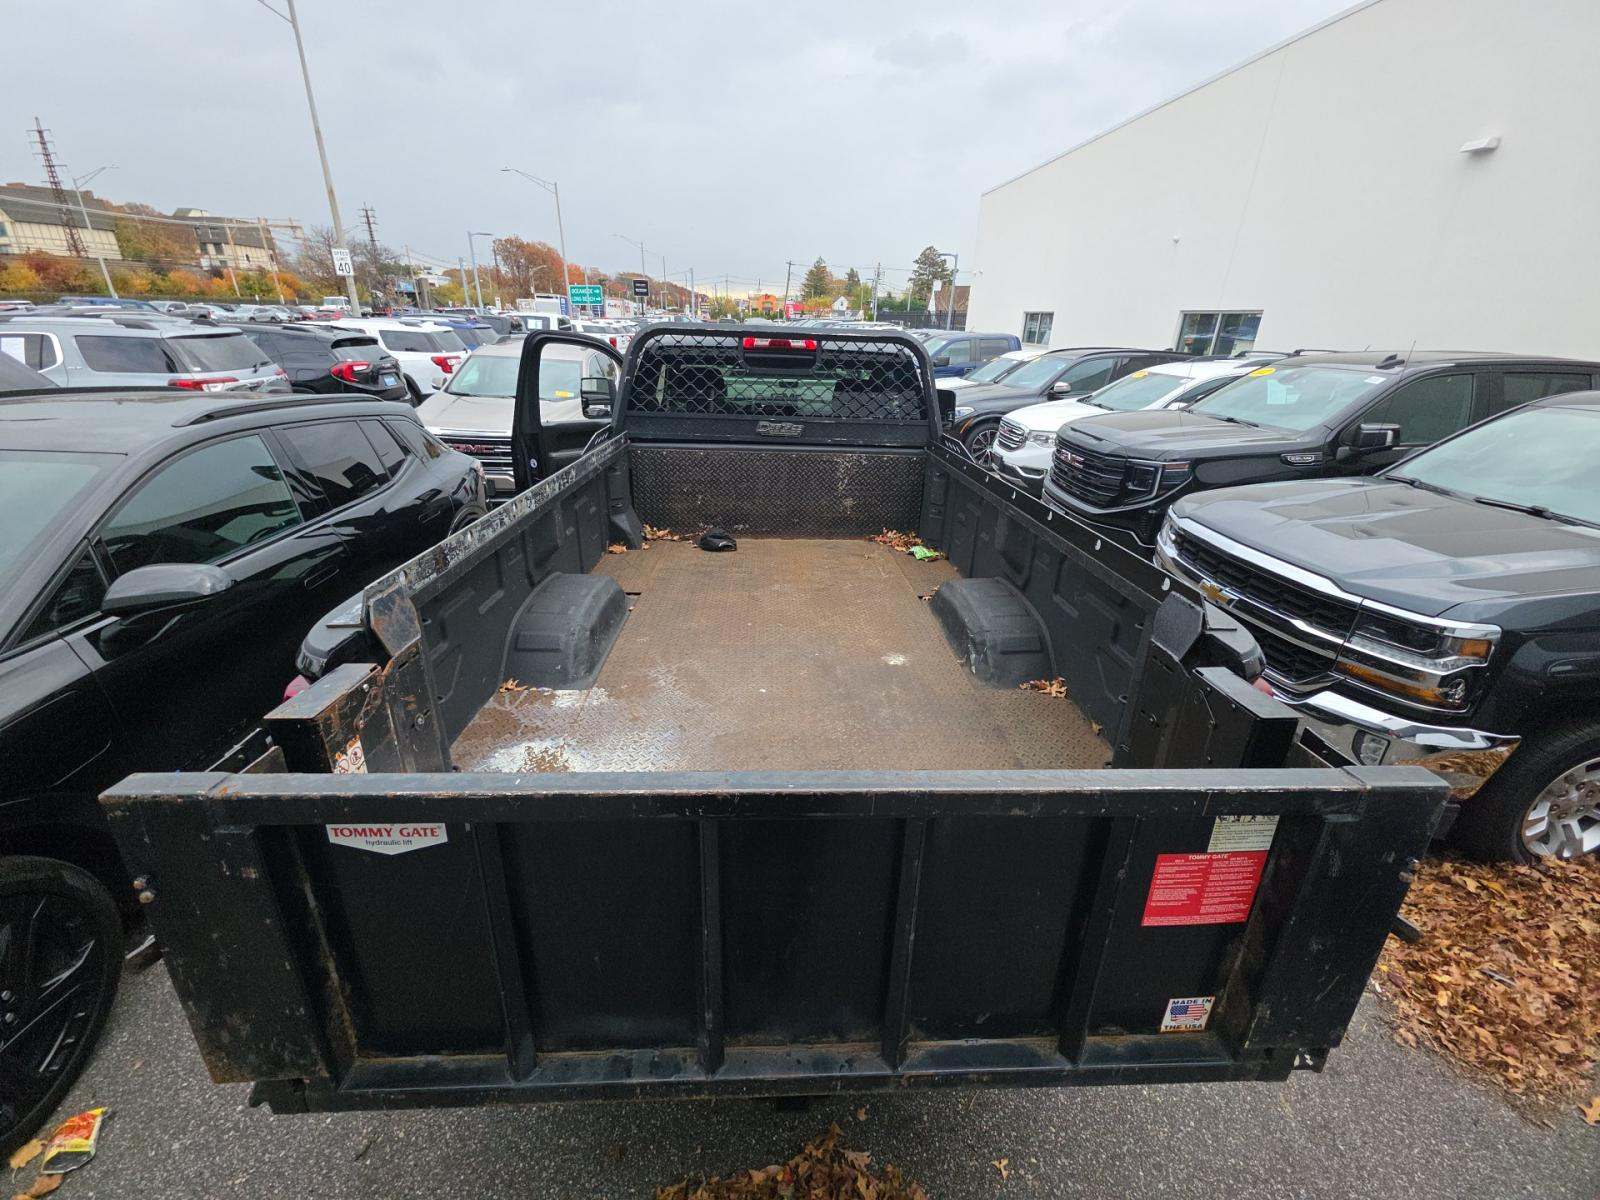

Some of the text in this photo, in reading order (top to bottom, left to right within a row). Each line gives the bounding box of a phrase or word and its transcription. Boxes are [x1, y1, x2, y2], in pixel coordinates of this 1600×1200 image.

[338, 262, 351, 274] 40
[331, 827, 440, 838] TOMMY GATE
[365, 839, 401, 847] hydraulic
